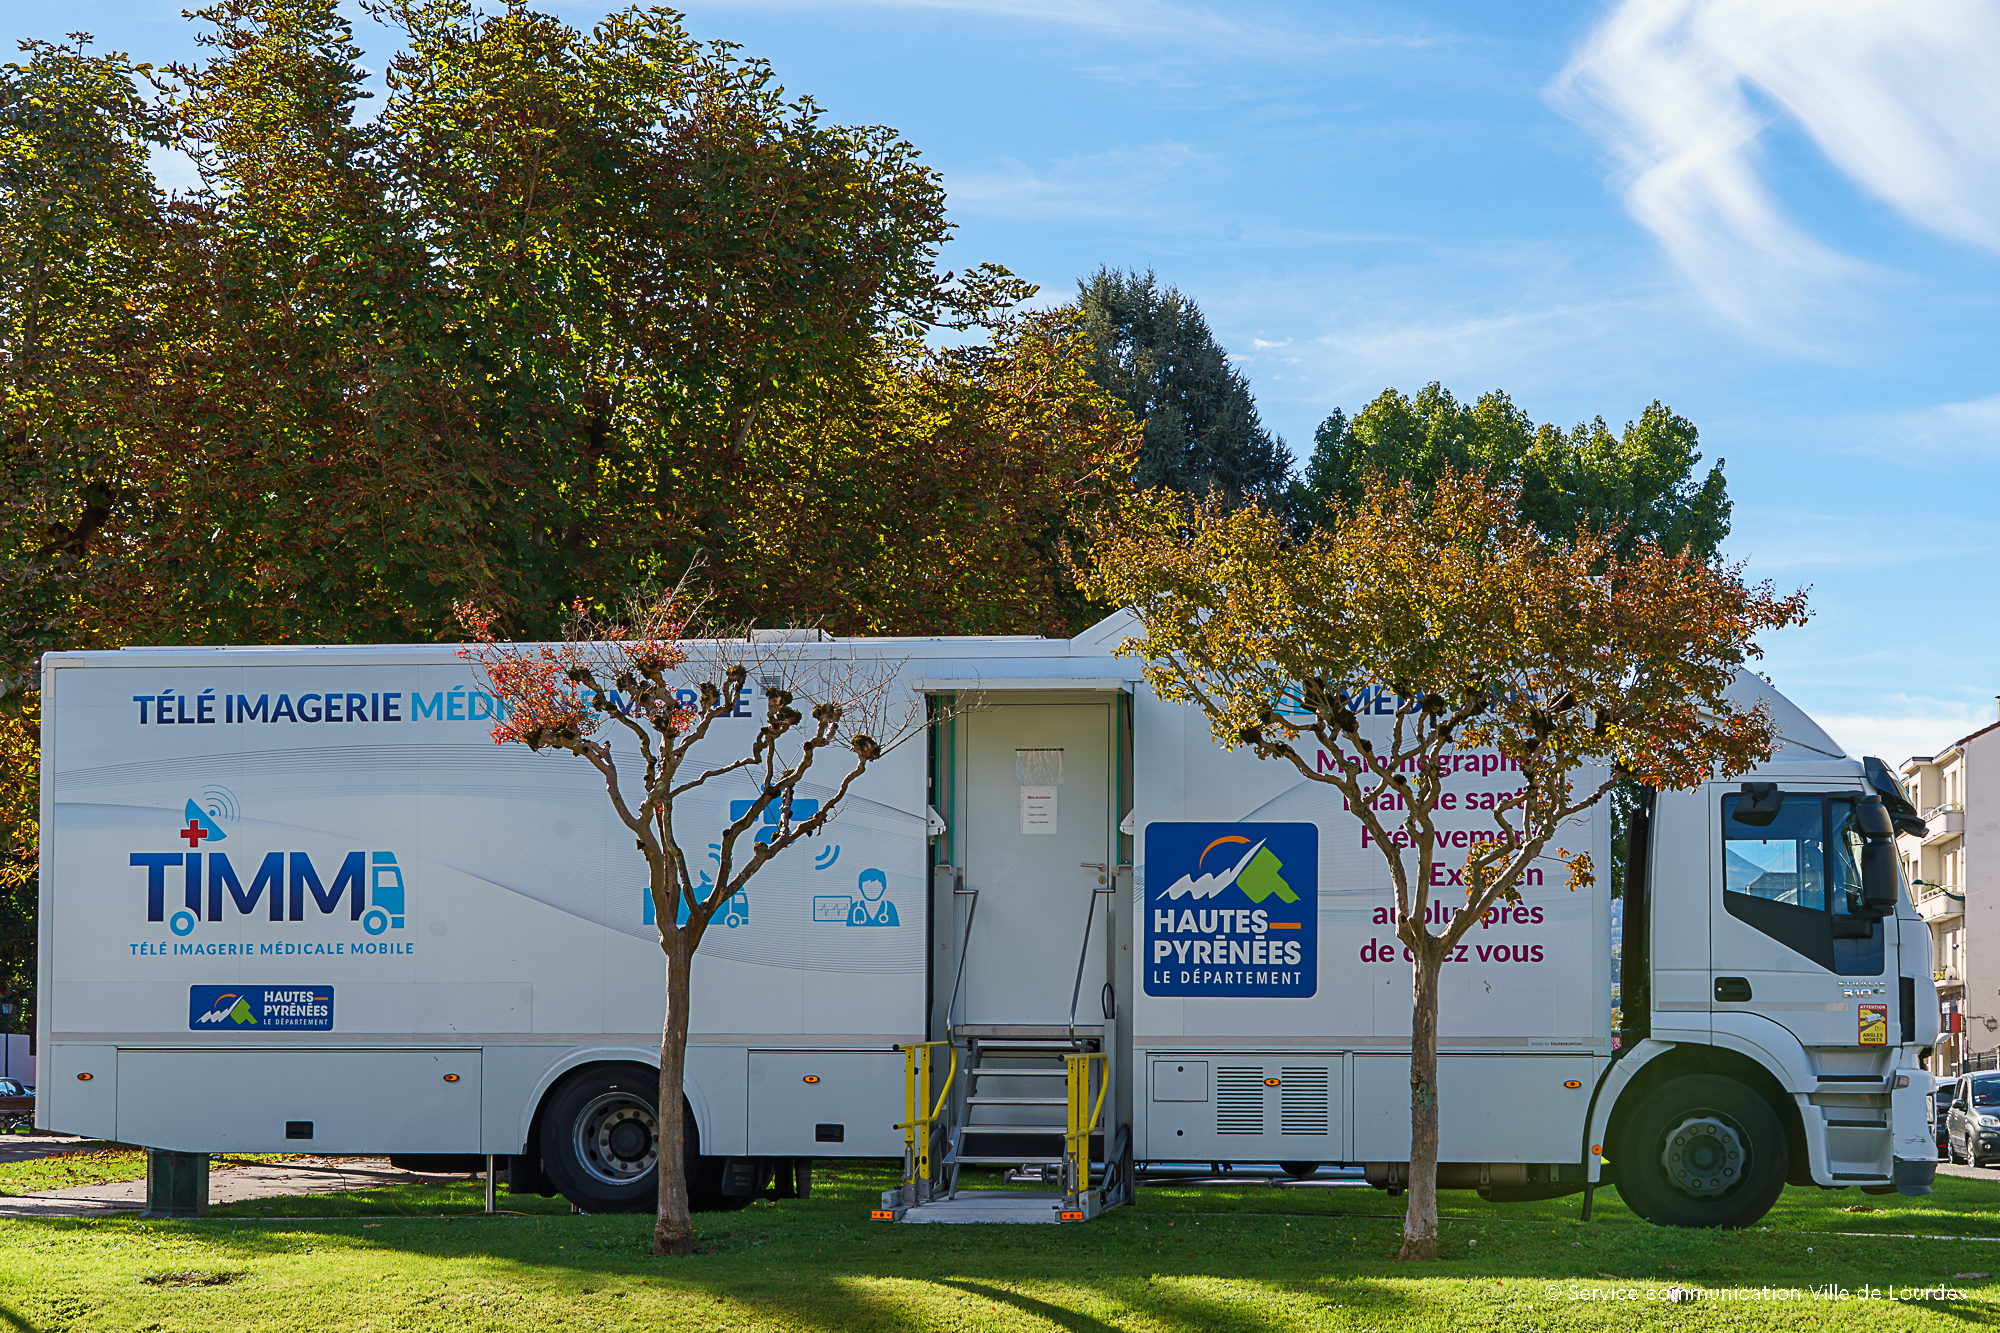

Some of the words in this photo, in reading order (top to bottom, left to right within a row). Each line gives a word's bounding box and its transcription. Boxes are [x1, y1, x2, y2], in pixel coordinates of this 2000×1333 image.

[132, 688, 216, 724] TÉLÉ
[225, 693, 402, 723] IMAGERIE
[411, 684, 600, 721] MÉDIE
[609, 688, 753, 718] MBLE
[1464, 787, 1542, 811] sant
[130, 851, 366, 922] TIMM
[1482, 900, 1544, 929] près
[130, 941, 167, 955] TÉLÉ
[173, 943, 254, 955] IMAGERIE
[260, 941, 345, 955] MÉDICALE
[350, 943, 414, 955] MOBILE
[1154, 935, 1301, 965] PYRÉNÉES
[1360, 938, 1395, 963] de
[1476, 945, 1544, 963] vous
[1154, 971, 1171, 984] LE
[1181, 968, 1302, 985] DÉPARTEMENT
[1843, 988, 1872, 998] 310
[264, 1003, 329, 1017] PYRÉNÉES
[275, 1018, 328, 1026] DÉPARTEMENT
